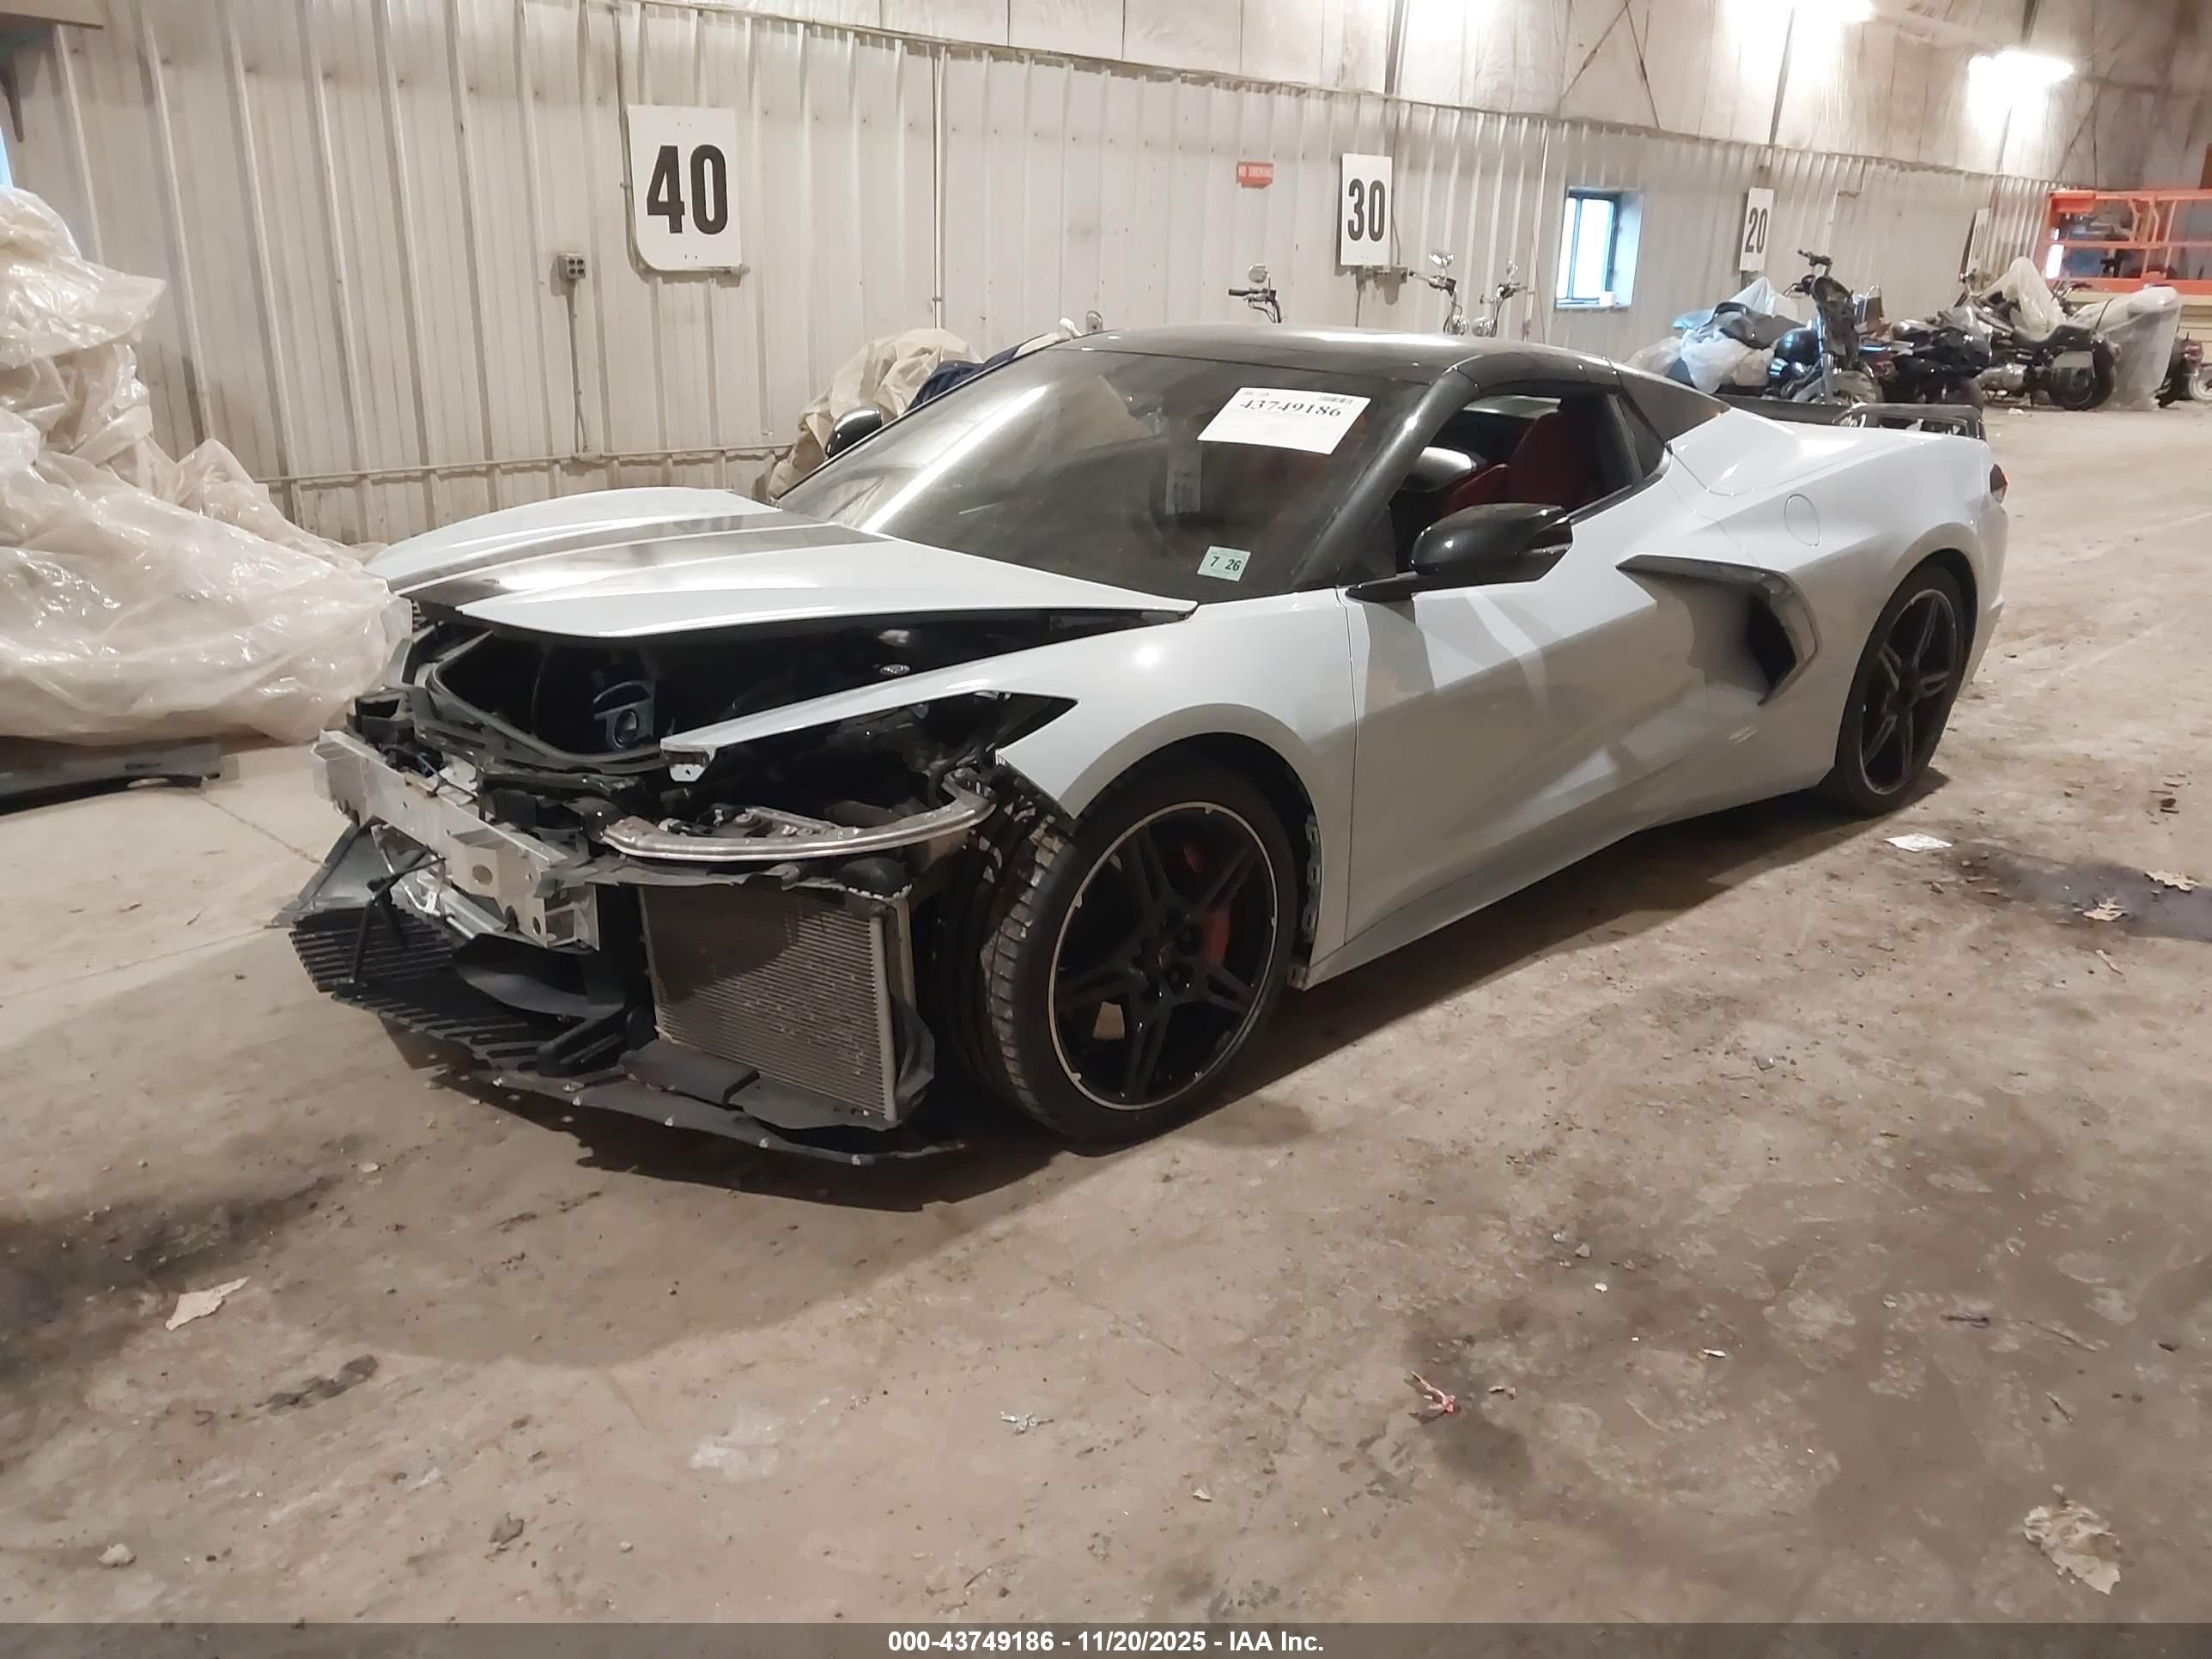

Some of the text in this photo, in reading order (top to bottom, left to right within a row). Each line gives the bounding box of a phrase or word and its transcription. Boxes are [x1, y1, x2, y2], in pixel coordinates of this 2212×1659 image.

[647, 144, 728, 235] 40
[1347, 179, 1386, 242] 30
[1745, 207, 1768, 254] 20
[1240, 399, 1341, 417] 43749186
[1210, 556, 1242, 571] 7 26
